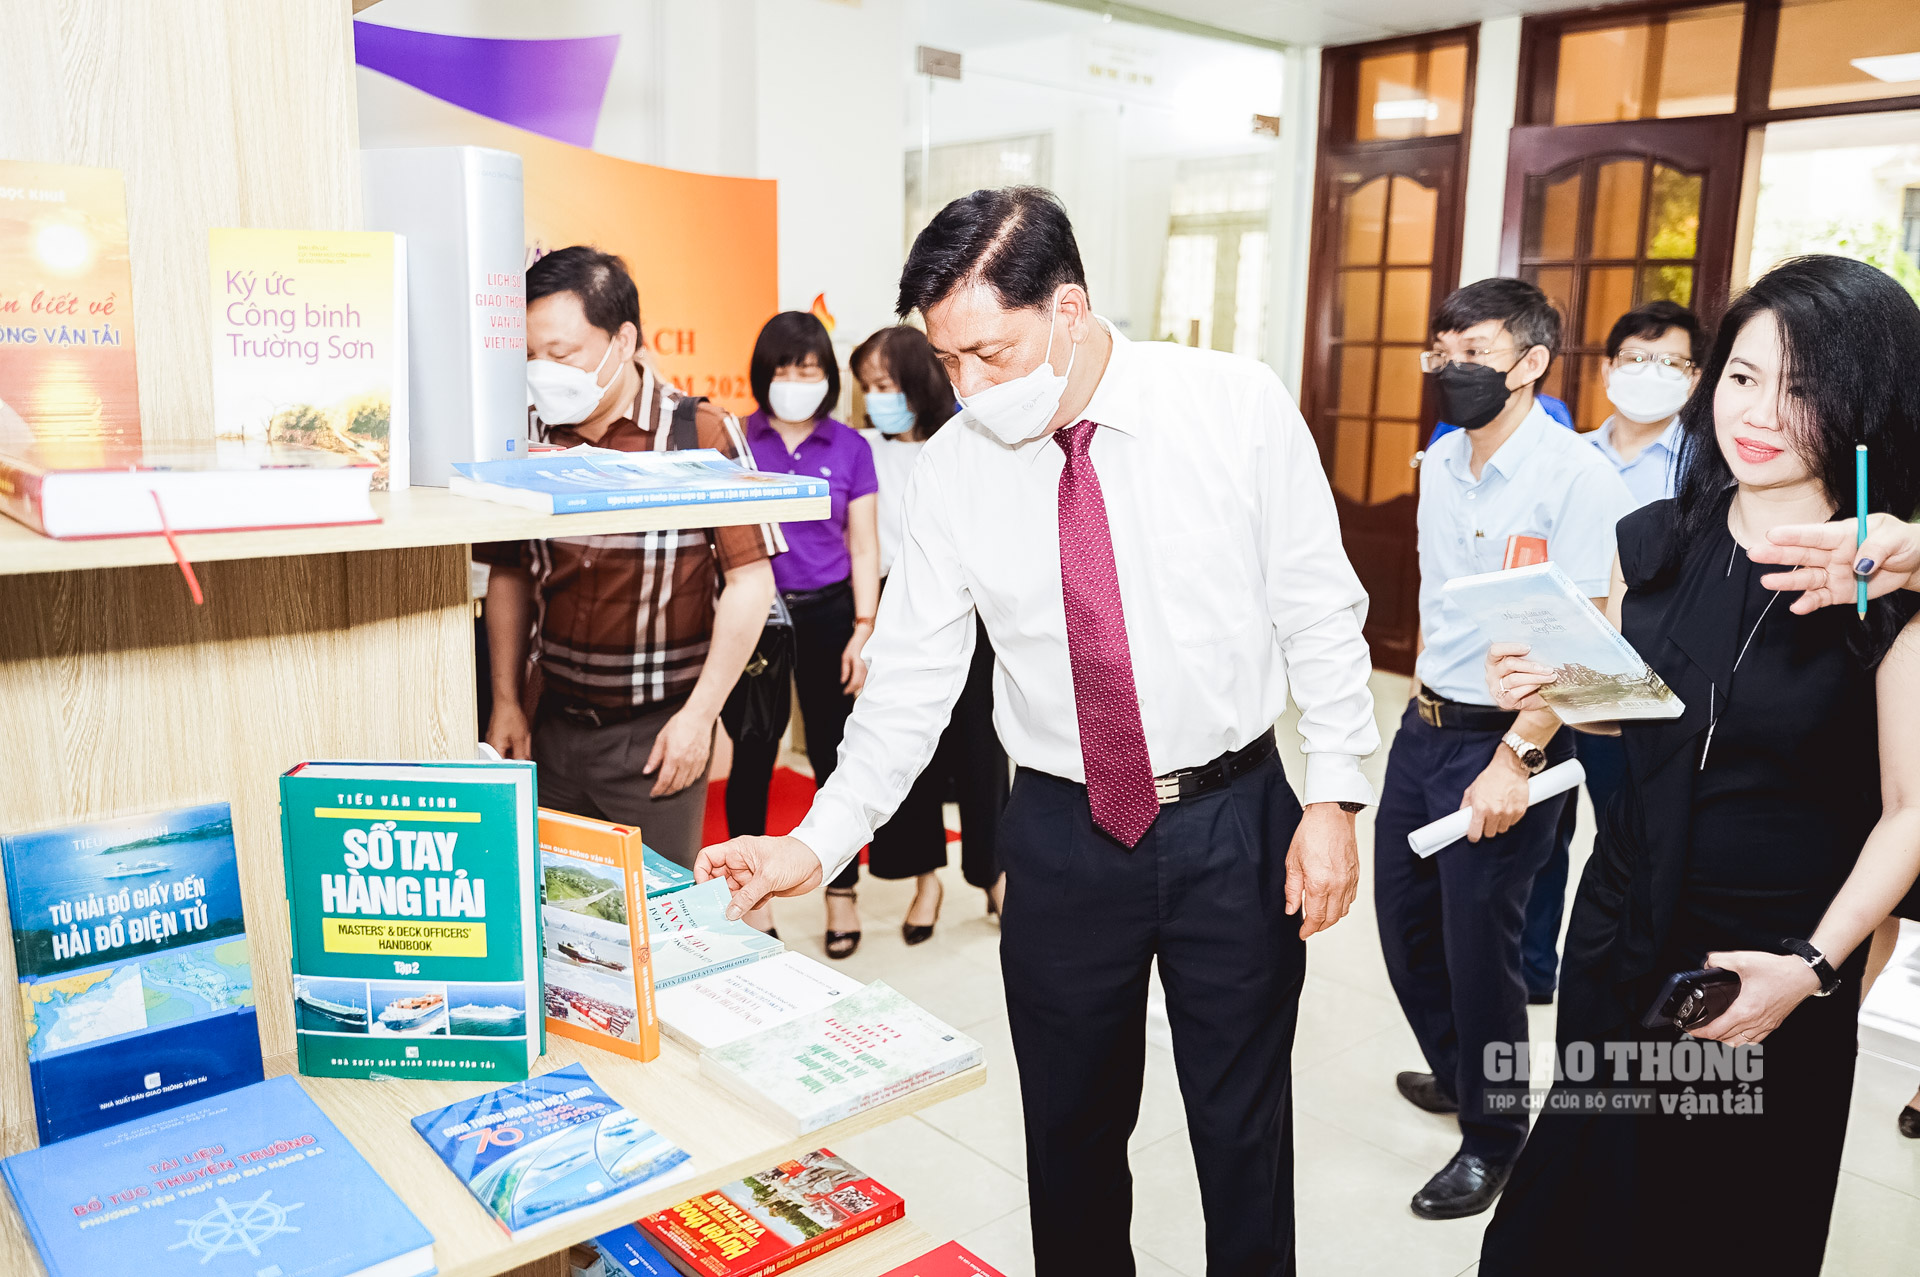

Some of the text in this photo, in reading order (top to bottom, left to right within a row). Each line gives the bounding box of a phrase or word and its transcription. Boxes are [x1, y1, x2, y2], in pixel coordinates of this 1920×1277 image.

[226, 270, 296, 301] Ký ức
[475, 293, 502, 307] GIAO
[31, 290, 79, 315] biết
[89, 292, 117, 316] về
[226, 301, 361, 333] Công binh
[0, 324, 120, 348] NG VẬN TẢI
[226, 332, 374, 365] Trường Sơn
[644, 329, 695, 355] CH
[706, 374, 747, 398] 202
[380, 793, 411, 808] VĂN
[418, 796, 458, 809] KINH
[343, 820, 459, 872] SỔ TAY
[552, 846, 569, 855] GIAO
[568, 849, 590, 860] THÔNG
[48, 874, 206, 927] TỪ HẢI ĐỒ GIẤY ĐẾN
[320, 867, 487, 918] HÀNG HẢI
[51, 898, 209, 961] HẢI ĐỒ ĐIỆN TỬ
[661, 901, 684, 932] NAM
[378, 939, 433, 952] HANDBOOK
[387, 926, 395, 937] &
[396, 926, 425, 938] DECK
[393, 960, 420, 976] Tập 2
[99, 1100, 115, 1111] NHÀ
[114, 1094, 132, 1106] XUẤT
[144, 1088, 163, 1098] GIAO
[162, 1082, 184, 1093] THÔNG
[183, 1077, 198, 1087] VẬN
[442, 1122, 471, 1138] GIAO
[468, 1110, 507, 1129] THÔNG
[504, 1105, 529, 1120] VẬN
[543, 1092, 568, 1108] VIỆT
[528, 1107, 613, 1137] (1945-2015)
[458, 1126, 525, 1155] 70
[148, 1144, 226, 1175] TÀI LIỆU
[109, 1185, 151, 1206] TÚC
[153, 1158, 236, 1192] THUYỀN
[79, 1205, 140, 1230] PHƯƠNG
[668, 1200, 711, 1229] thoạ
[698, 1222, 751, 1261] Huyền
